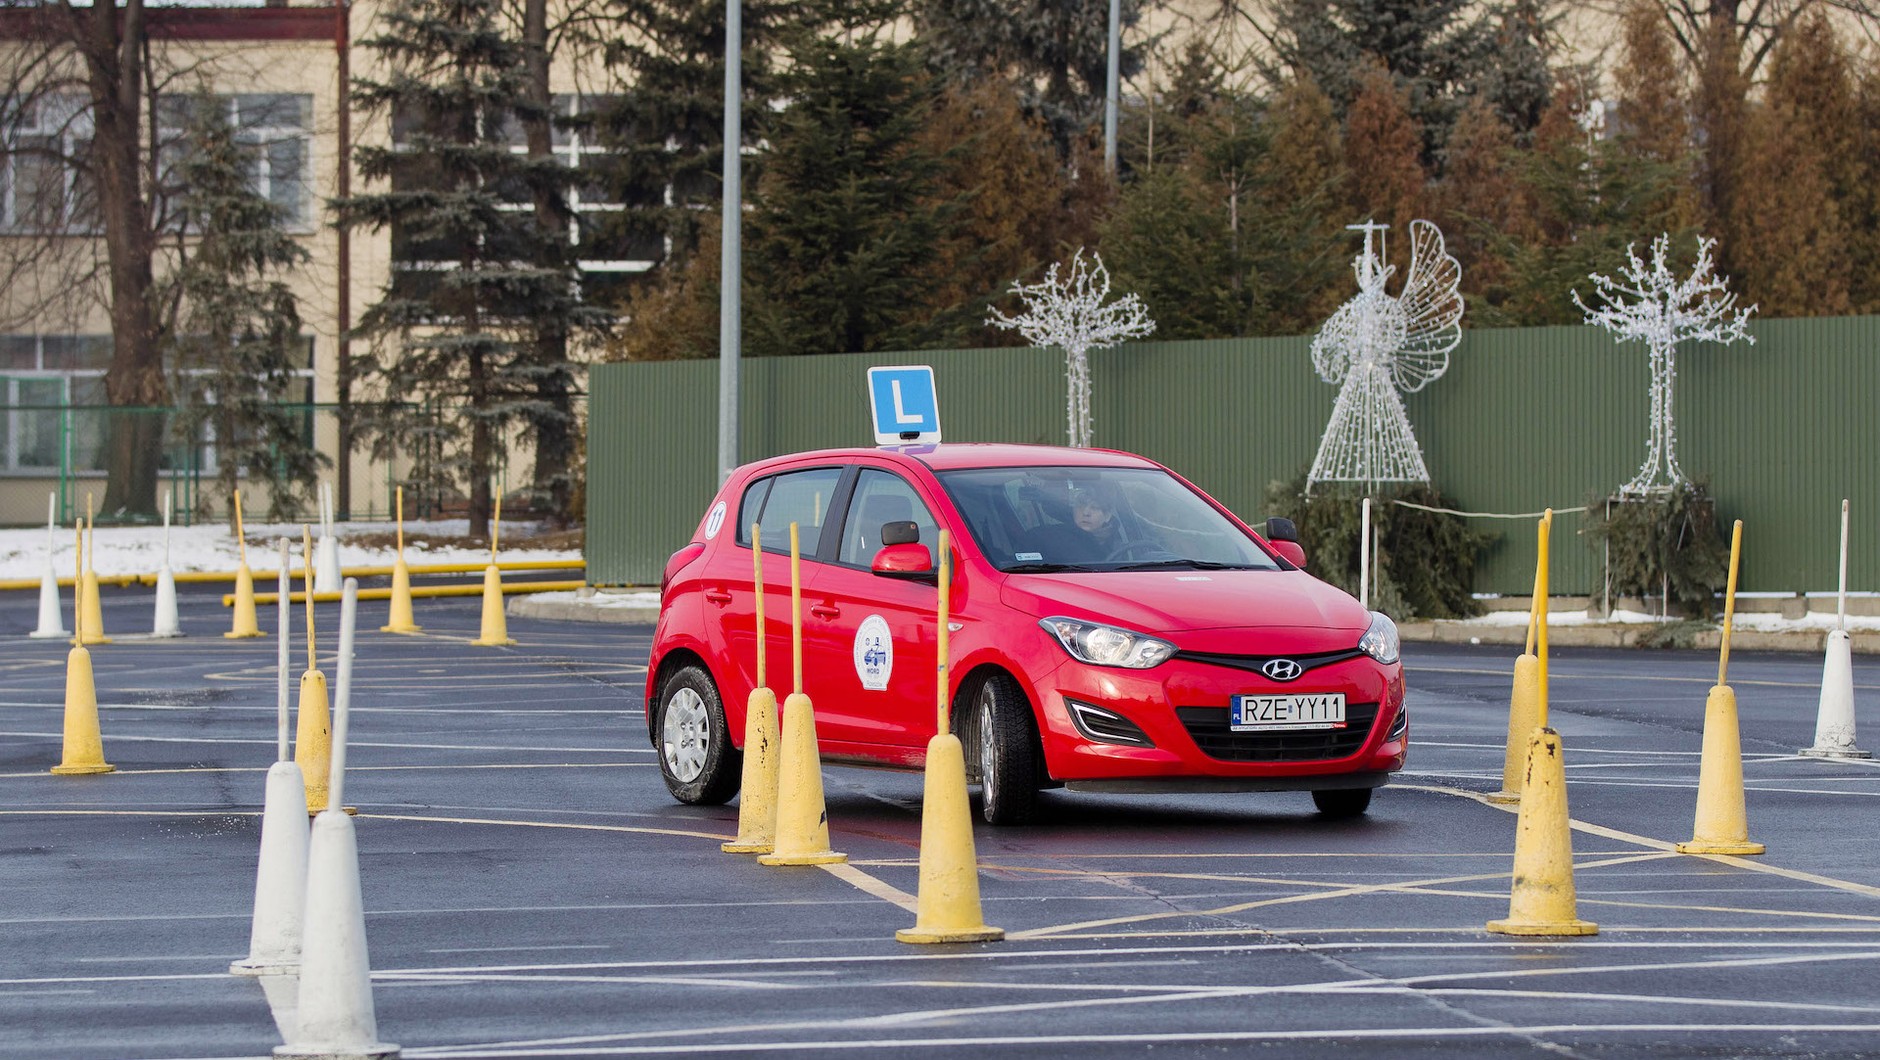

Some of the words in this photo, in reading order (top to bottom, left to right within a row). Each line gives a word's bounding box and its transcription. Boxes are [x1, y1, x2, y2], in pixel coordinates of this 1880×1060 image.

[891, 380, 923, 424] L
[708, 508, 724, 532] 11
[1245, 698, 1287, 721] RZE
[1295, 697, 1338, 719] YY11
